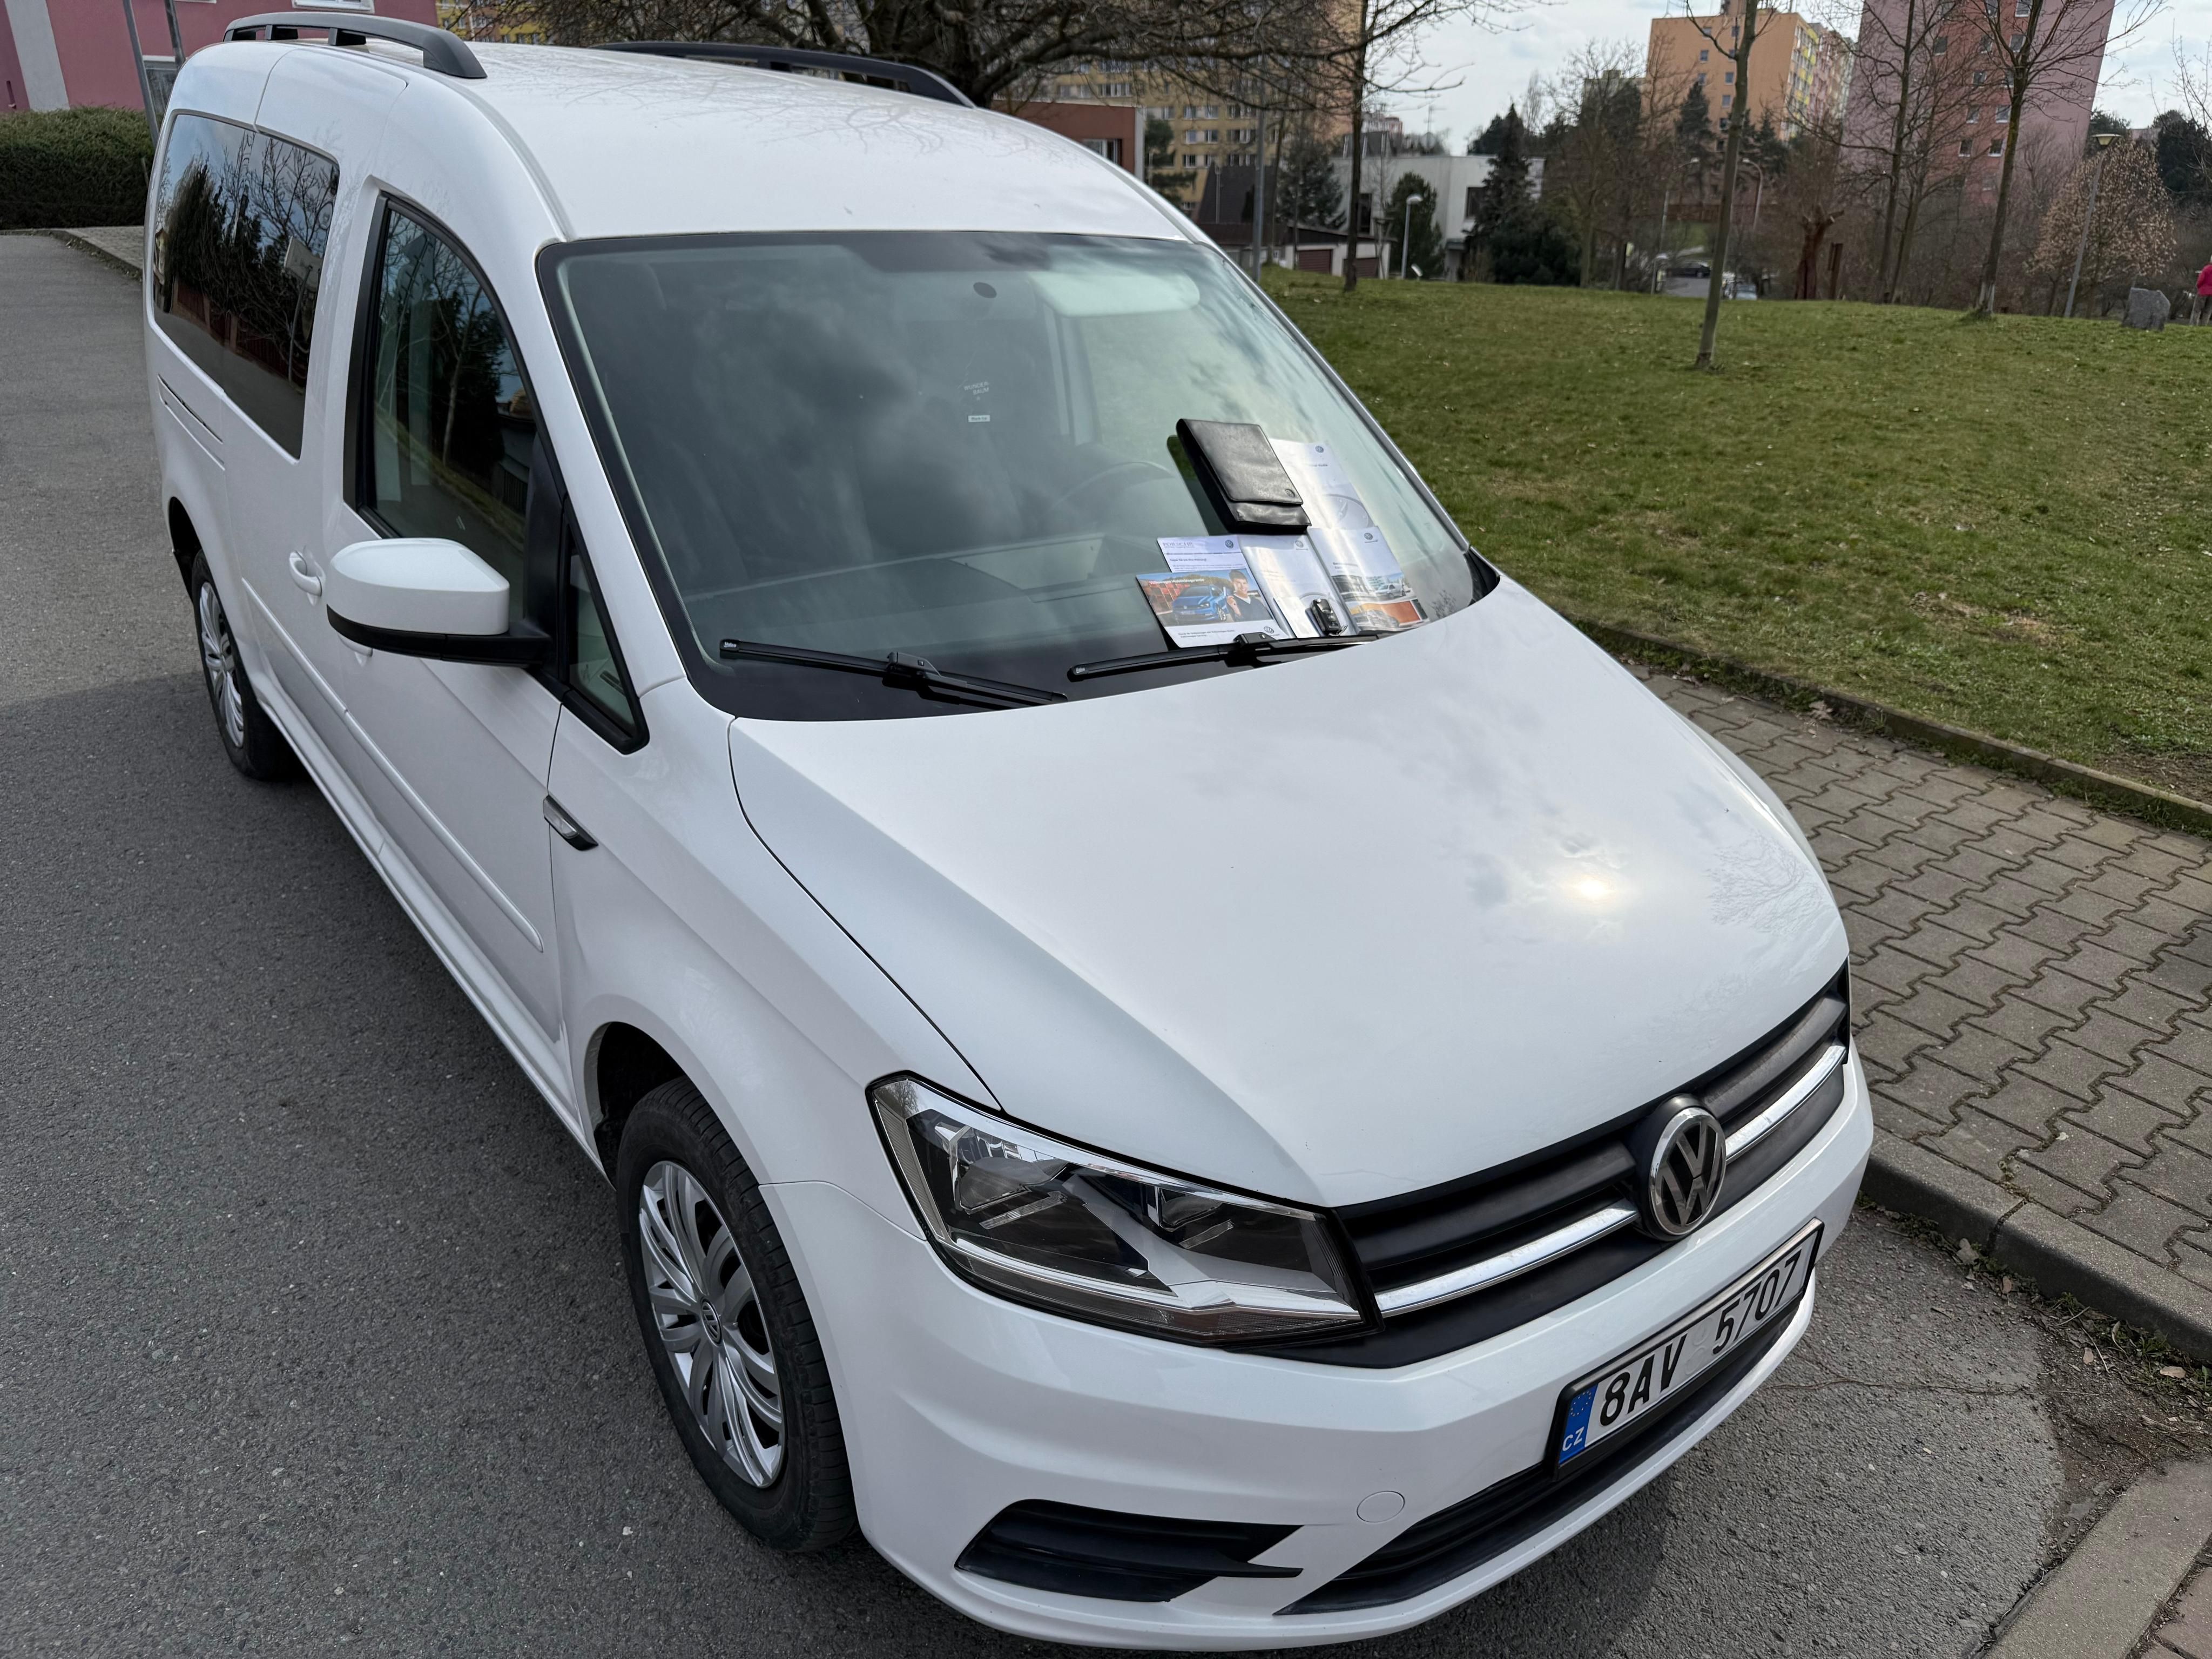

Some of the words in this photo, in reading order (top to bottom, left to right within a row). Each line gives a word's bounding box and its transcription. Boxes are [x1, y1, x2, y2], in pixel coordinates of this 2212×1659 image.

[1650, 1109, 1725, 1234] VW
[1600, 1333, 1688, 1426] 8AV
[1712, 1249, 1802, 1355] 5707
[1562, 1426, 1584, 1452] CZ
